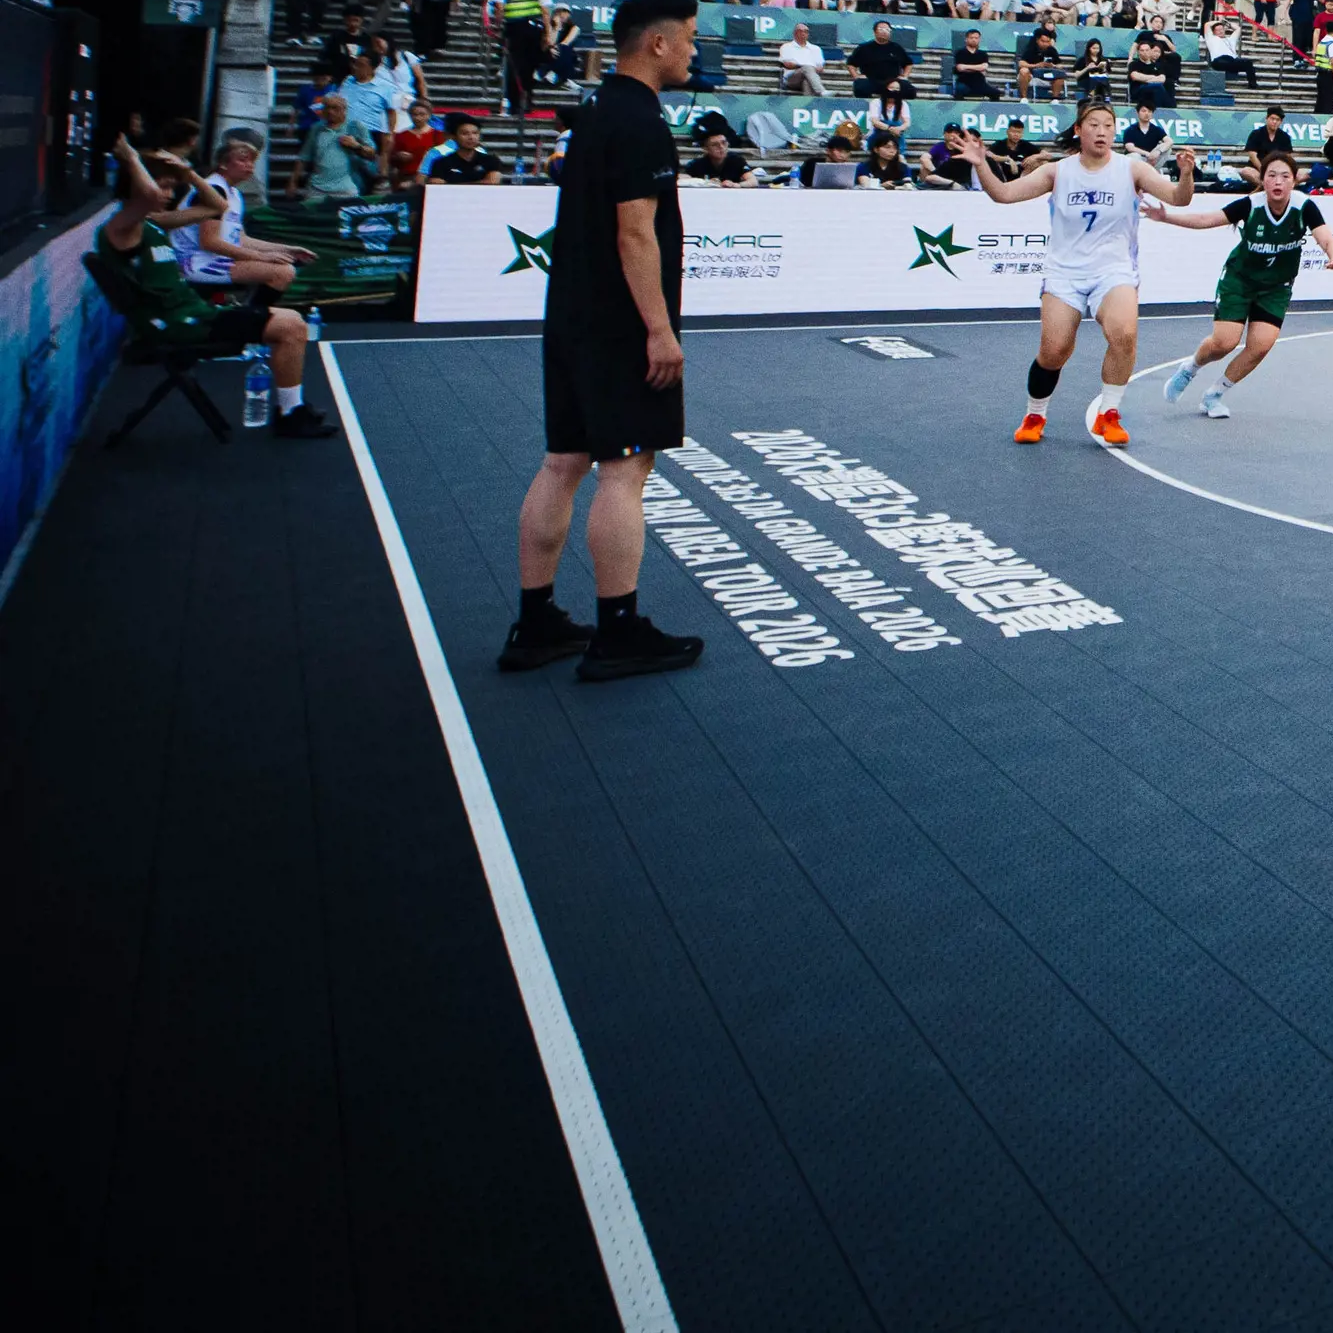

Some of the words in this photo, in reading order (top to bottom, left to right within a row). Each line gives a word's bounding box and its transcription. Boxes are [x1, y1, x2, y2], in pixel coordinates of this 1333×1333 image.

[1081, 211, 1097, 232] 7
[688, 252, 759, 263] Production
[762, 252, 782, 263] Ltd
[1266, 256, 1276, 267] 7
[683, 265, 781, 279] 製作有限公司
[693, 470, 751, 485] DE
[709, 482, 773, 501] 3x3
[731, 501, 794, 519] DA
[655, 526, 748, 566] AREA
[755, 518, 861, 571] GRANDE
[694, 563, 799, 616] TOUR
[814, 569, 913, 610] BAÍA
[858, 607, 962, 651] 2026
[737, 614, 855, 667] 2026
